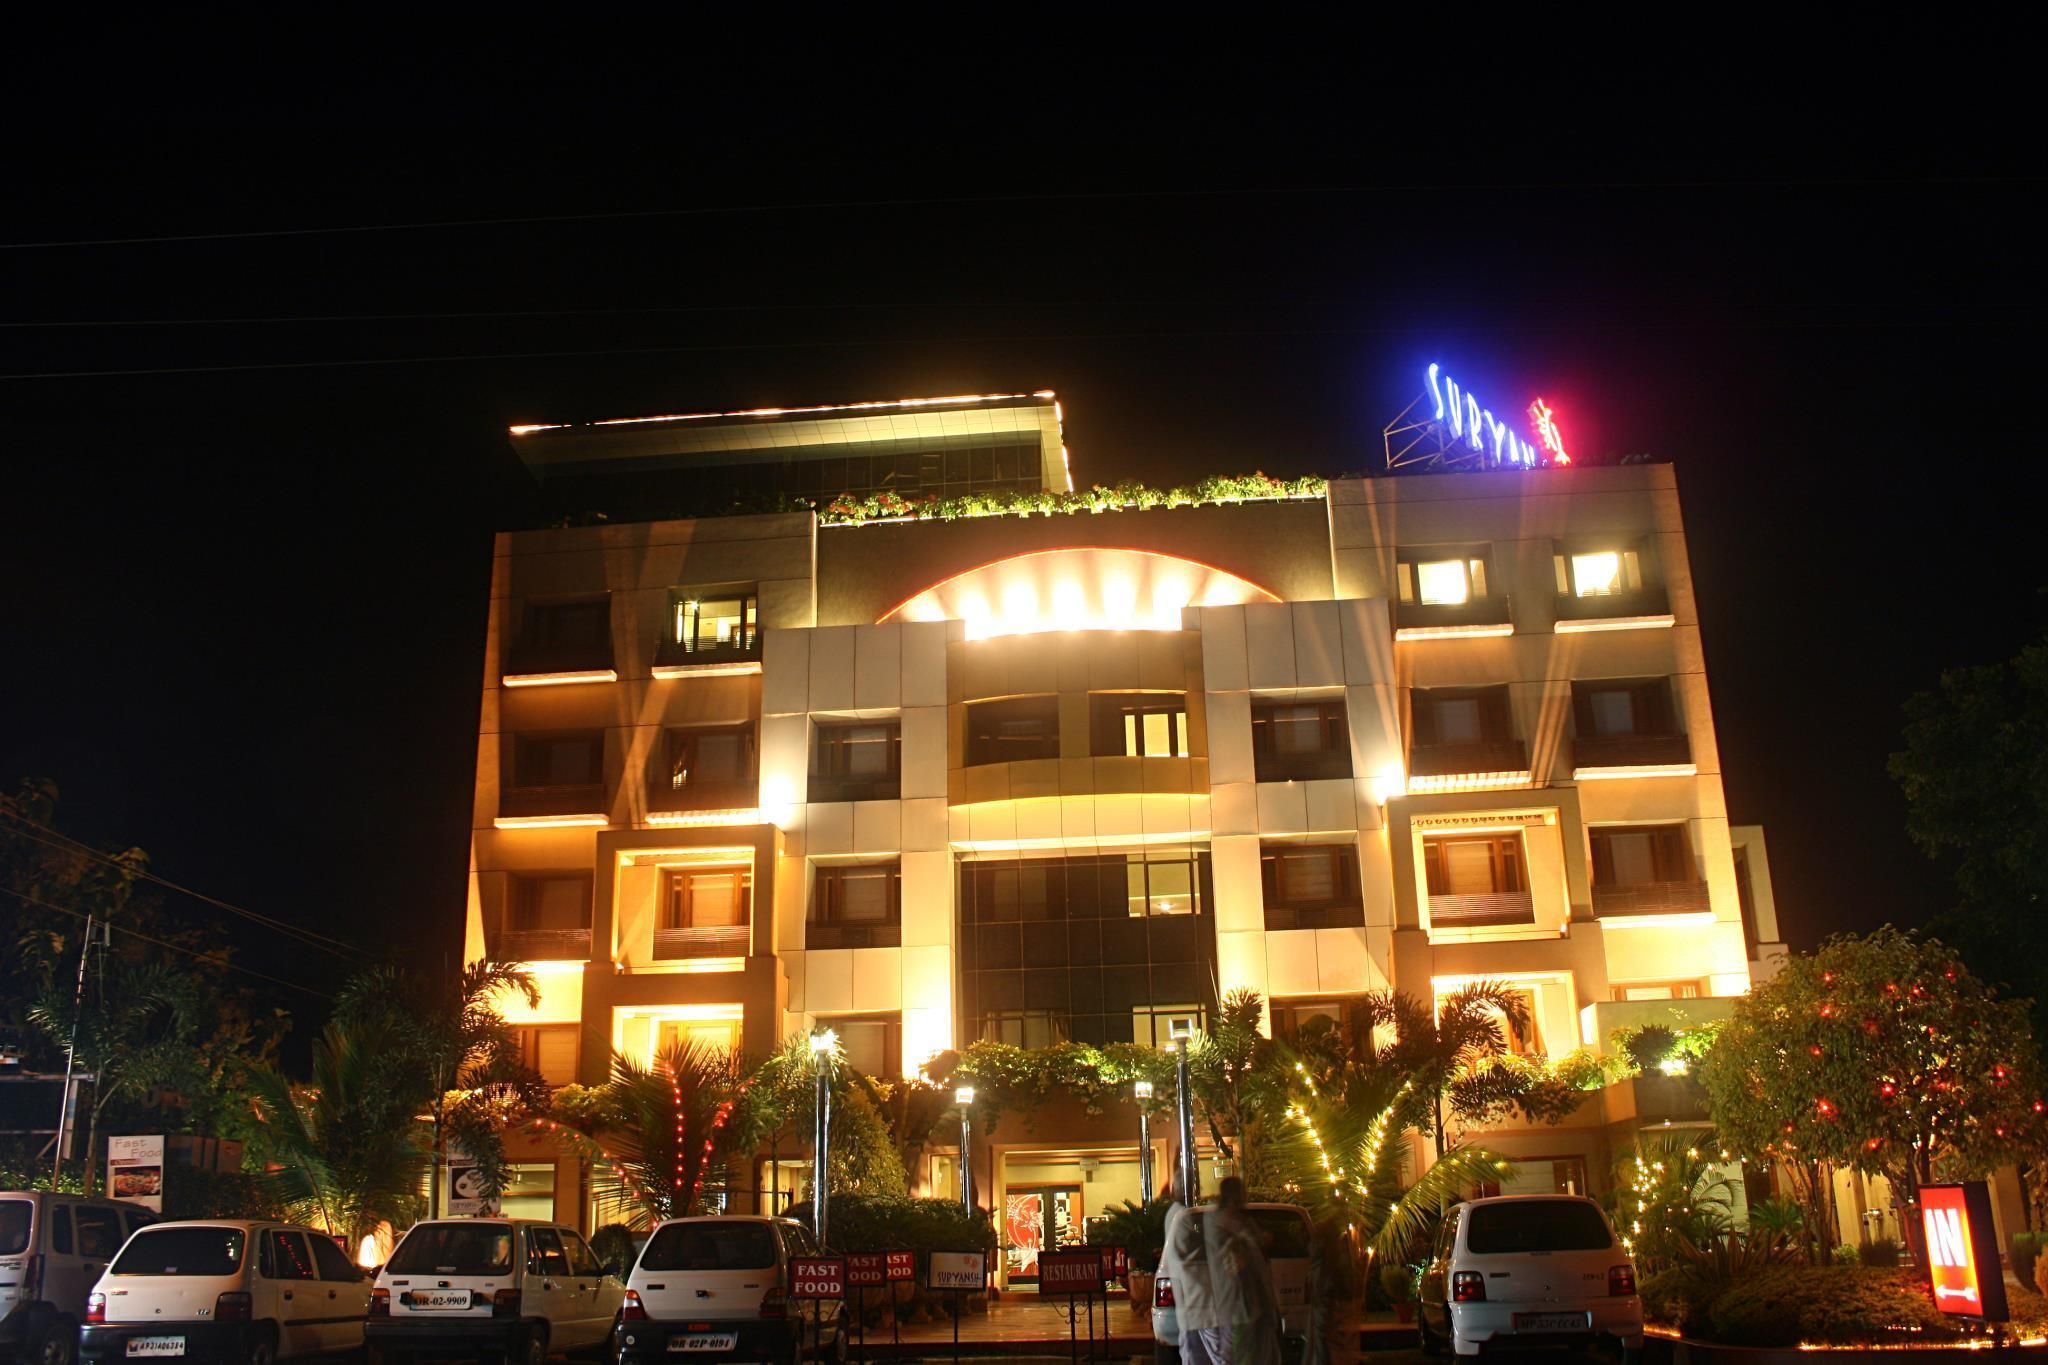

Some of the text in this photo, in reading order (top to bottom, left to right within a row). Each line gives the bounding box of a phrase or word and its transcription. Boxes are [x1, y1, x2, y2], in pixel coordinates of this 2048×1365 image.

[115, 1139, 147, 1148] Fast
[1924, 1208, 1968, 1267] IN
[848, 1257, 880, 1267] AST
[797, 1265, 838, 1276] FAST
[849, 1271, 881, 1281] OOD
[1042, 1263, 1098, 1281] RESTAURANT
[794, 1282, 841, 1293] FOOD
